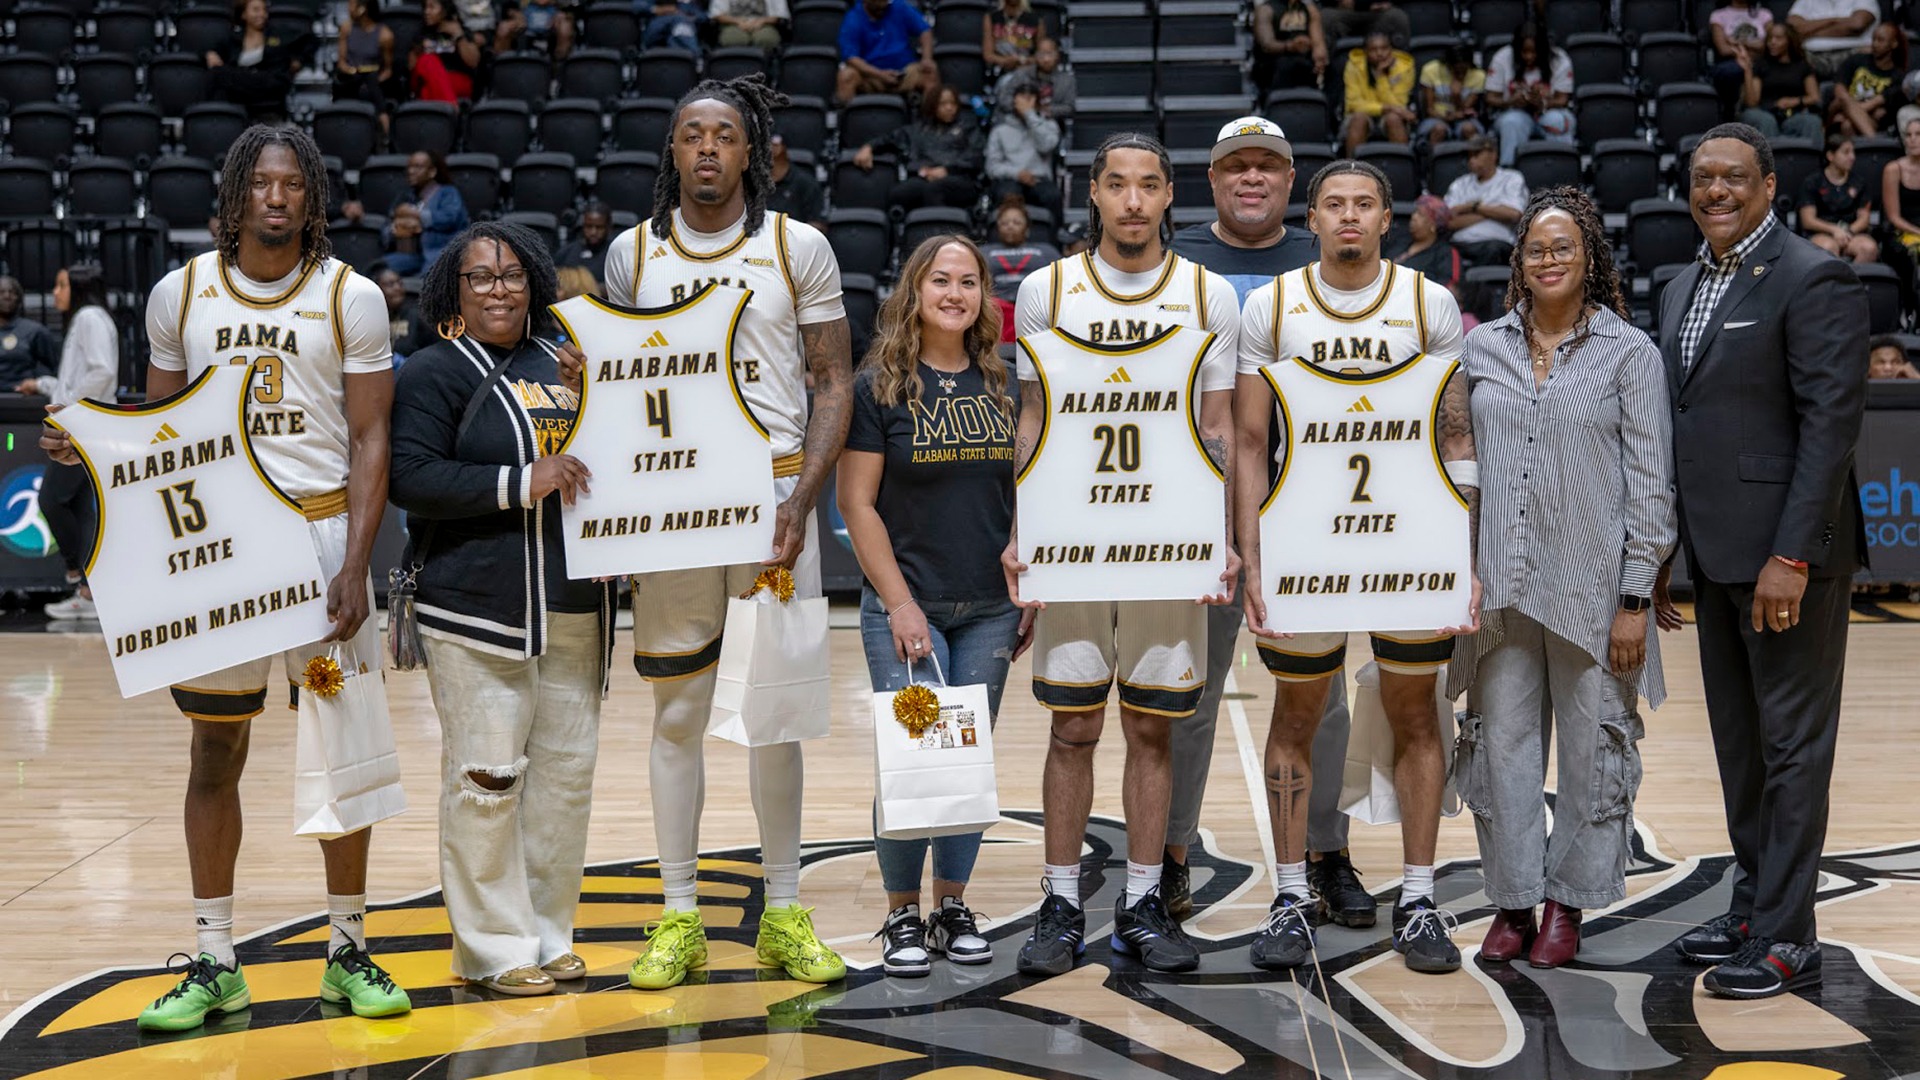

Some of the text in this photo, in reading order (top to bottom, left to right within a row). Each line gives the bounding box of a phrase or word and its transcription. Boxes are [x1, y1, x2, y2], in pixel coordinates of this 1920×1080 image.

[215, 323, 299, 357] BAMA
[1312, 336, 1393, 365] BAMA
[230, 355, 284, 404] 3
[595, 351, 718, 383] ALABAMA
[644, 388, 672, 439] 4
[1059, 391, 1177, 413] ALABAMA
[248, 411, 306, 436] ATE
[908, 395, 1017, 446] MOM
[1301, 420, 1421, 443] ALABAMA
[110, 433, 236, 489] ALABAMA
[633, 449, 697, 473] STATE
[912, 448, 958, 463] ALABAMA
[960, 447, 986, 460] STATE
[1093, 423, 1141, 473] 20
[1089, 484, 1152, 503] STATE
[1347, 453, 1373, 504] 2
[156, 478, 208, 540] 13
[580, 505, 760, 539] MARIO ANDREWS
[1332, 514, 1396, 534] STATE
[168, 537, 233, 575] STATE
[1030, 543, 1213, 564] ASJON ANDERSON
[1276, 572, 1456, 595] MICAH SIMPSON
[115, 579, 322, 658] JORDON MARSHALL
